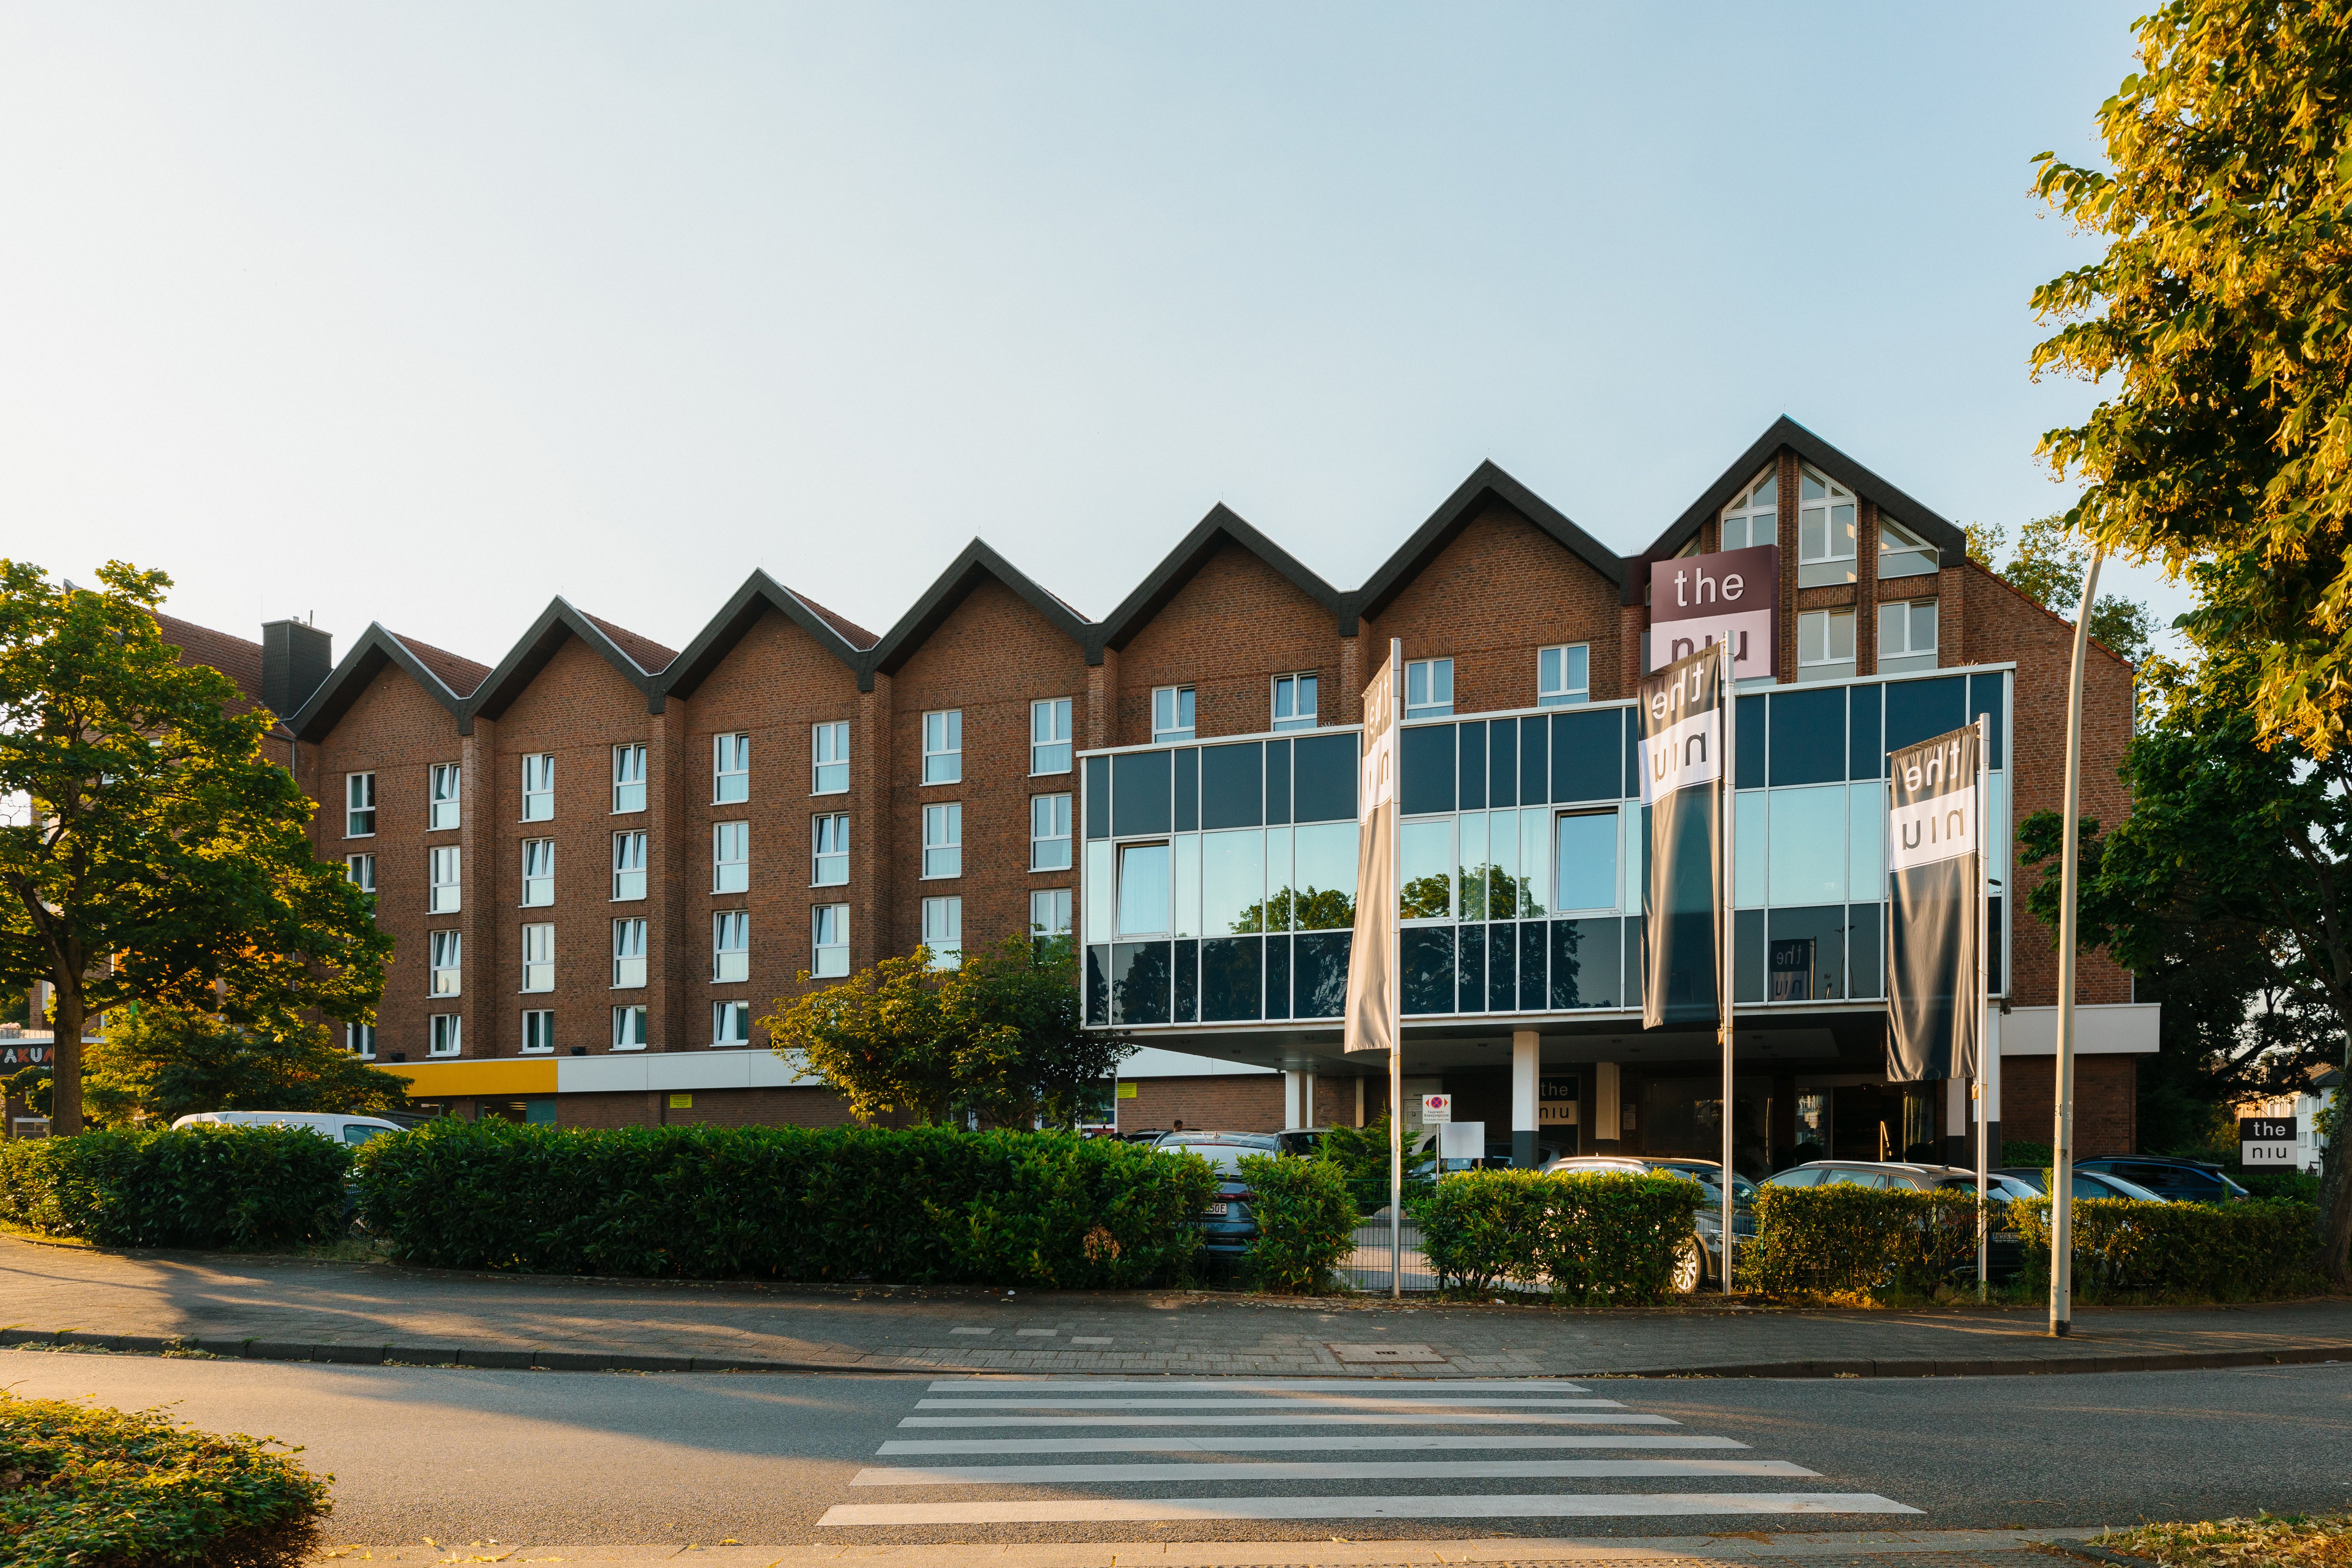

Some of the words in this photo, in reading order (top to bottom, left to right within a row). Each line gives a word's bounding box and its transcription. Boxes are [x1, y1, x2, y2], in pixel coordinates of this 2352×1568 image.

[1674, 567, 1744, 607] the
[1540, 1082, 1568, 1096] the
[1539, 1107, 1569, 1119] niu
[2254, 1122, 2286, 1136] the
[2252, 1147, 2286, 1158] niu
[1206, 1204, 1225, 1213] 50E
